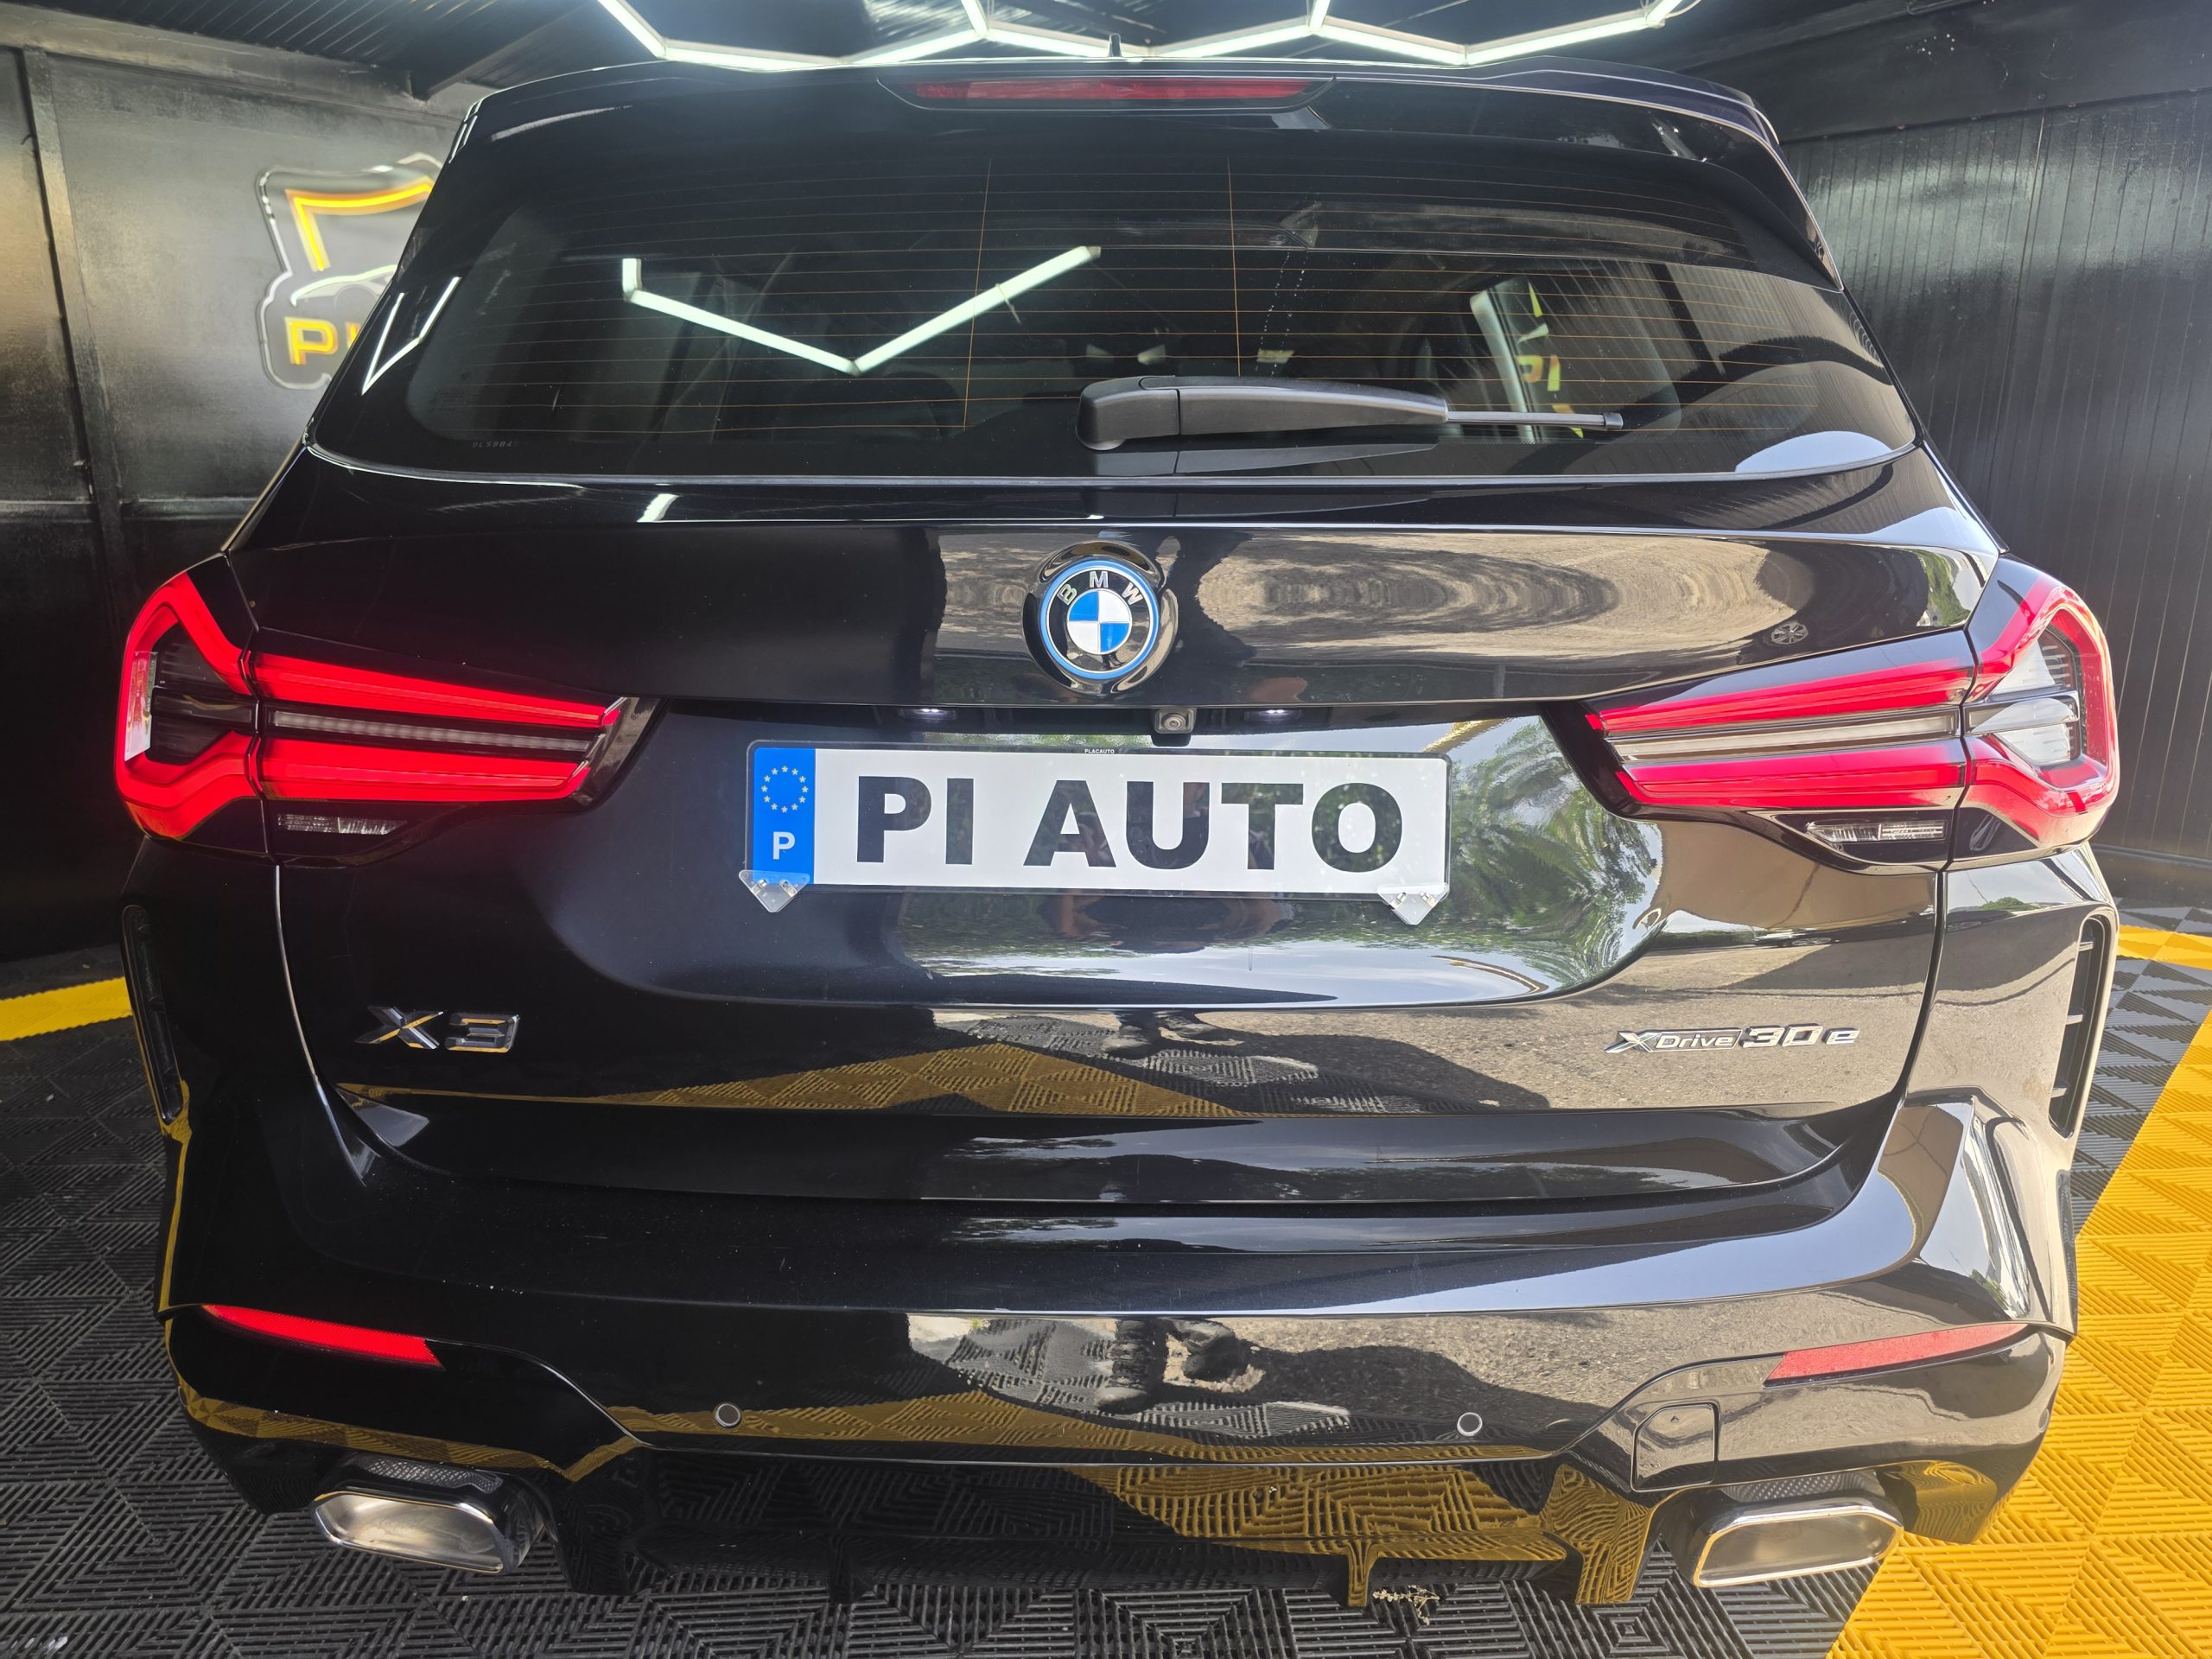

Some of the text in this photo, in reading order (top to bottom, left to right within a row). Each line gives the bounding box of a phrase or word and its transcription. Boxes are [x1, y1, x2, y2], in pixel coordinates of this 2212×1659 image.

[1057, 570, 1144, 606] BMW
[857, 775, 1402, 873] PI AUTO
[773, 831, 796, 861] P
[354, 1005, 520, 1053] X3
